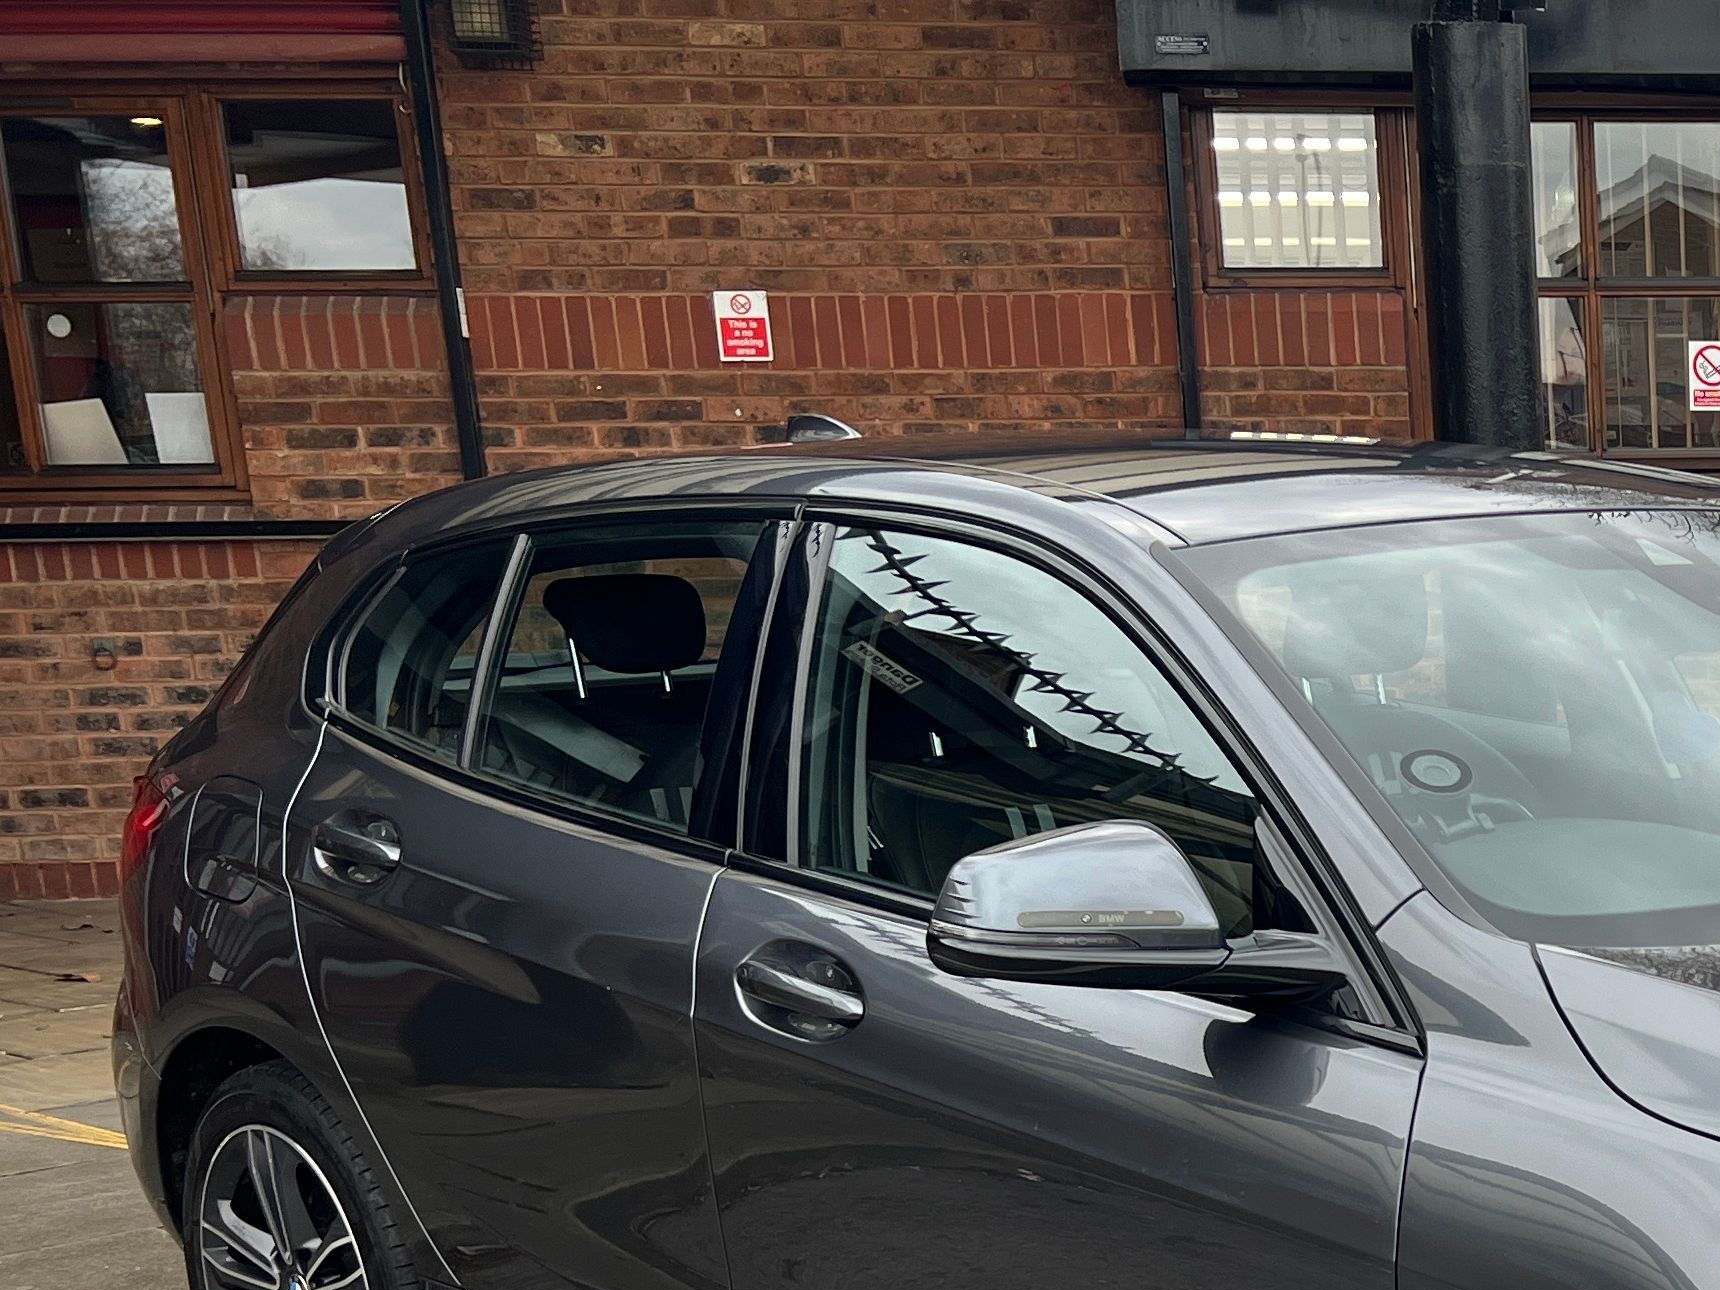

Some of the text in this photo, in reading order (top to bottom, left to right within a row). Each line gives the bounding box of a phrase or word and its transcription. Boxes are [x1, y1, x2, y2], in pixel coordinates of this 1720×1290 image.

[728, 320, 758, 329] This is
[727, 338, 764, 348] smoking
